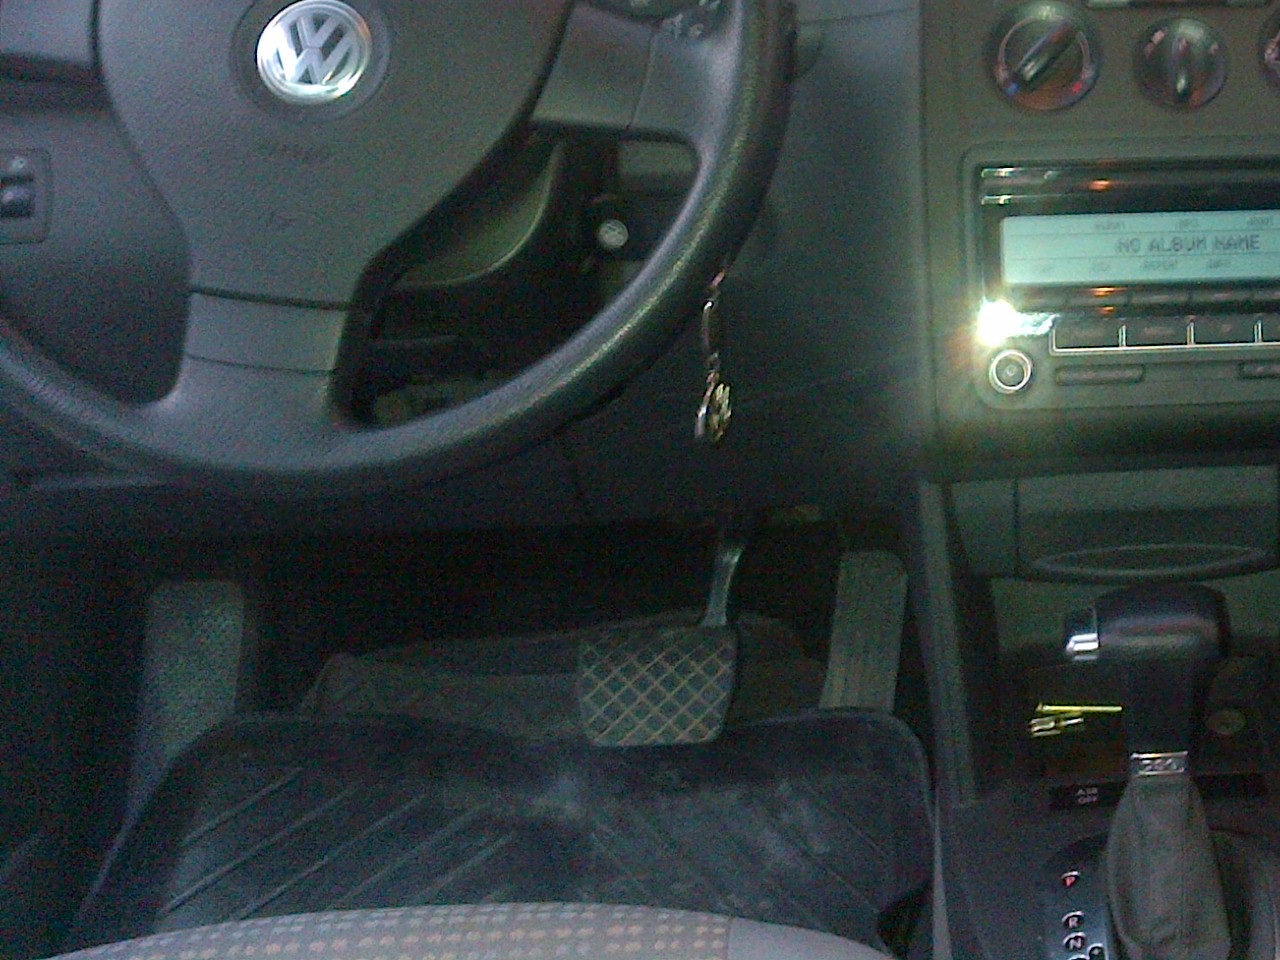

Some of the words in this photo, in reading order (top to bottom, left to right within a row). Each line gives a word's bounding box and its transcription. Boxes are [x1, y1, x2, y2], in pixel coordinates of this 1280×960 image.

[1117, 238, 1141, 253] NO
[1149, 236, 1207, 253] ALBUM
[1215, 234, 1260, 250] NAME
[1069, 937, 1082, 951] N
